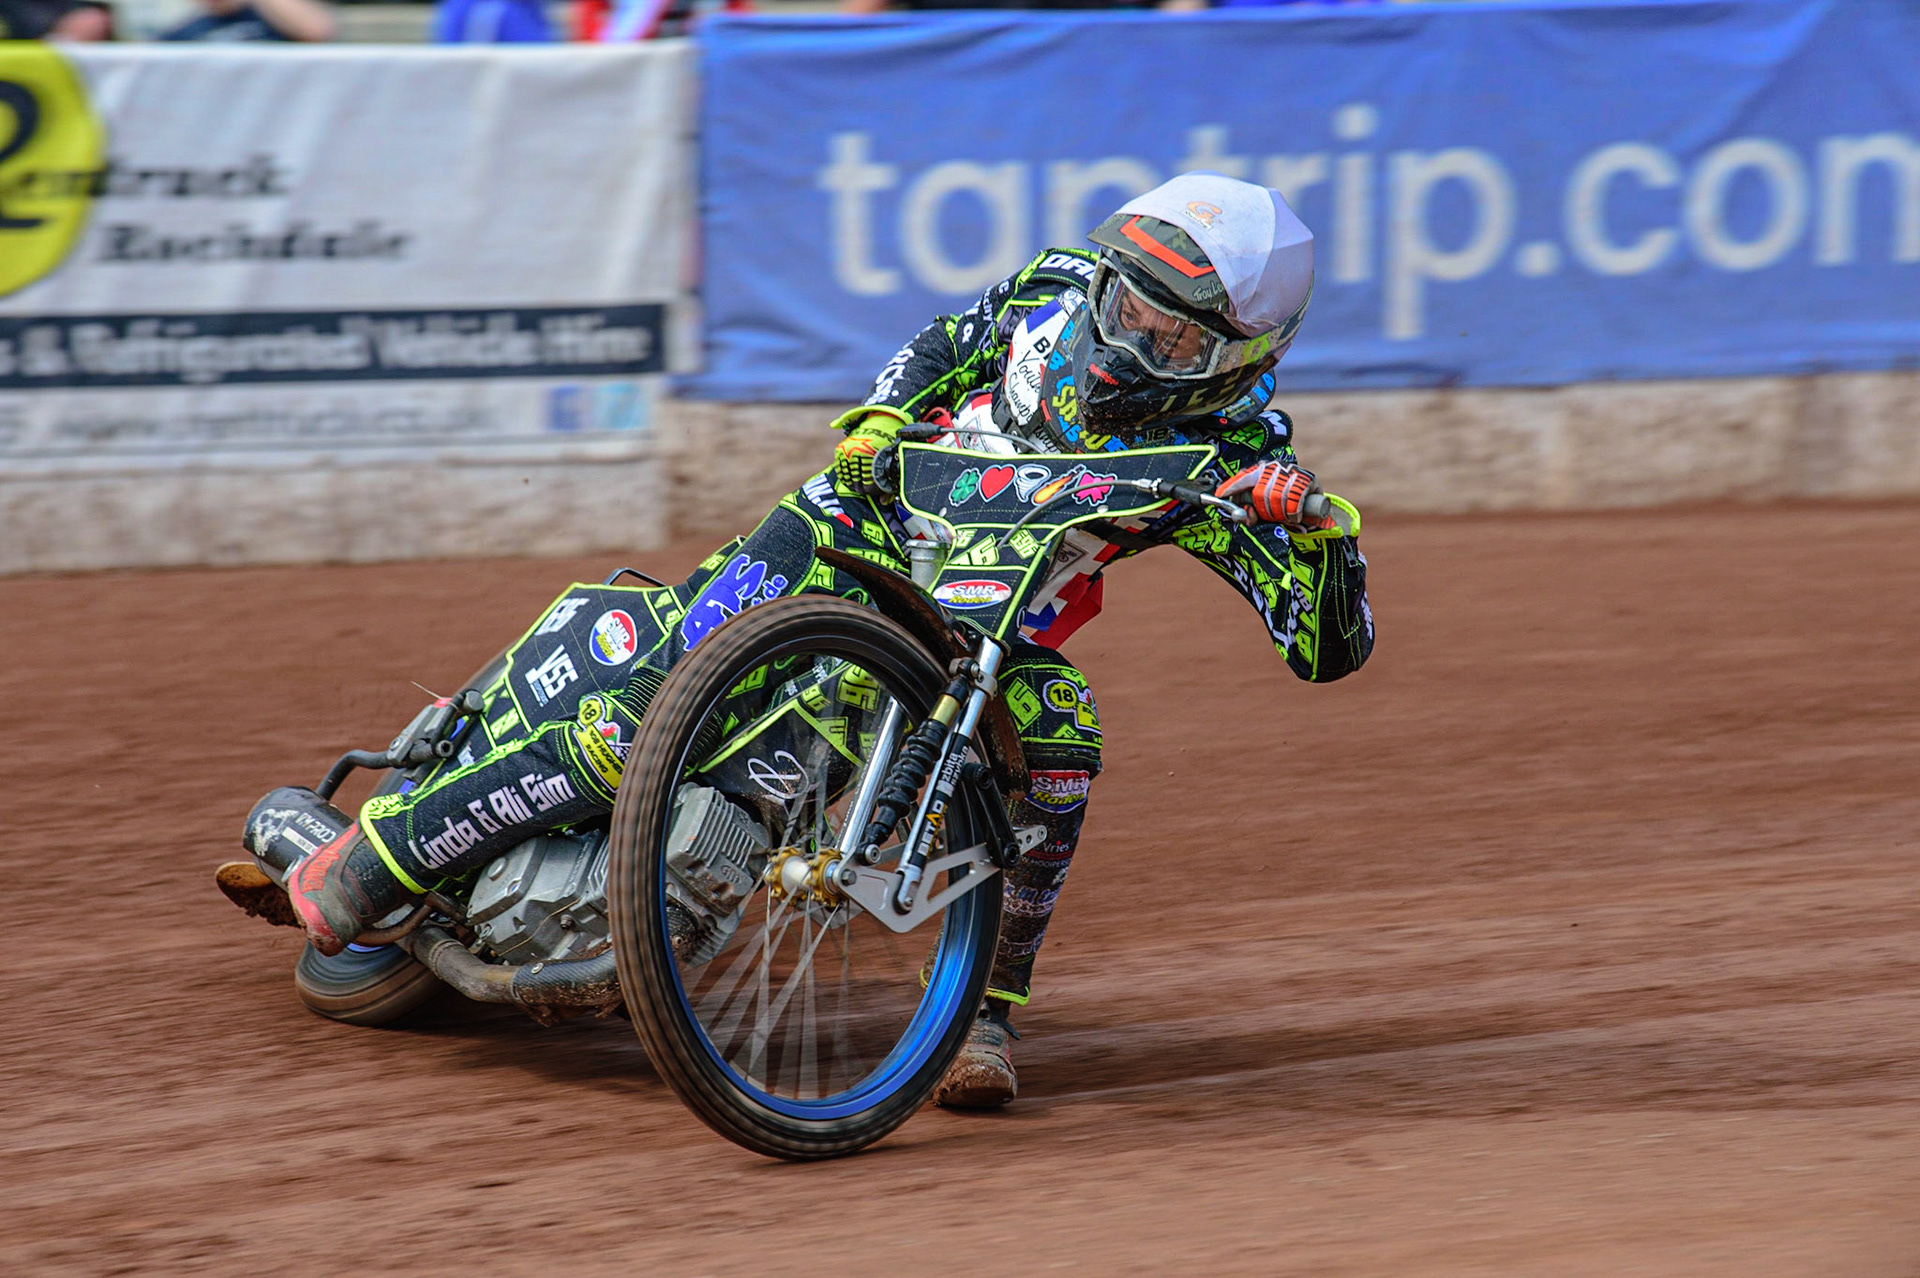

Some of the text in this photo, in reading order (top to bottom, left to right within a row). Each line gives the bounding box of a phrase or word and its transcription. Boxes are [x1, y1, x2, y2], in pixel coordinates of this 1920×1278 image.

[952, 584, 996, 596] SMR
[1053, 688, 1074, 703] 18
[582, 703, 597, 721] 18
[1034, 776, 1087, 793] SMR
[1032, 790, 1085, 805] Roden
[408, 773, 576, 869] Linda & Ali Sim
[1043, 841, 1070, 852] Vries
